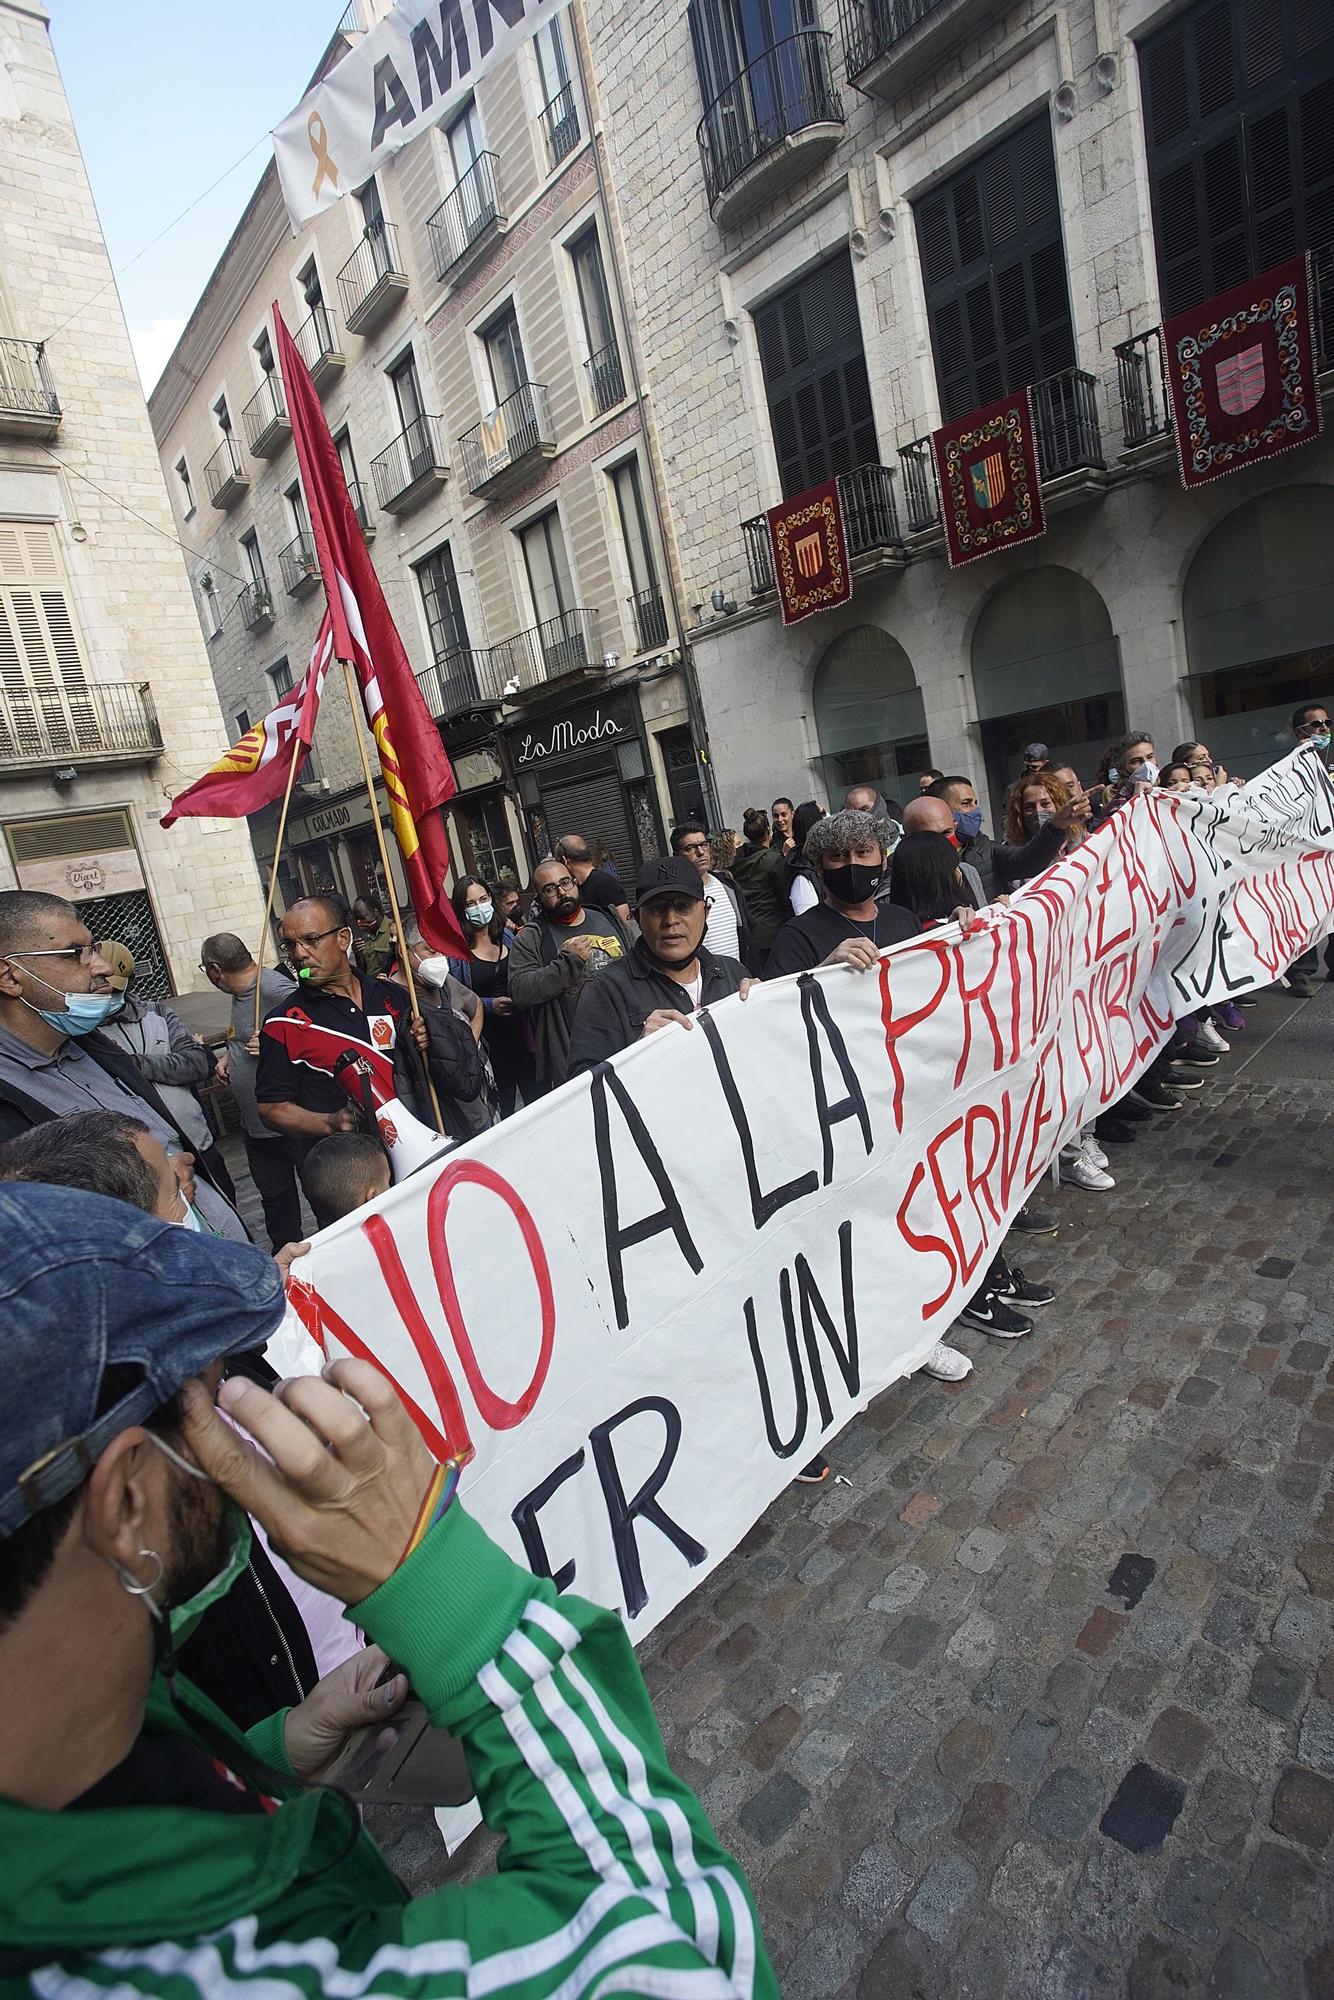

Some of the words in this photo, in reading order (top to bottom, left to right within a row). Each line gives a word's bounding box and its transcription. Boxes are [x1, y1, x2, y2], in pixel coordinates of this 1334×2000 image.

[371, 0, 545, 152] AMN
[312, 806, 351, 833] COLMADO
[286, 1158, 557, 1467] NO
[587, 1060, 705, 1331] A
[695, 972, 874, 1230] LA
[511, 1396, 708, 1620] ER
[743, 1220, 860, 1460] UN
